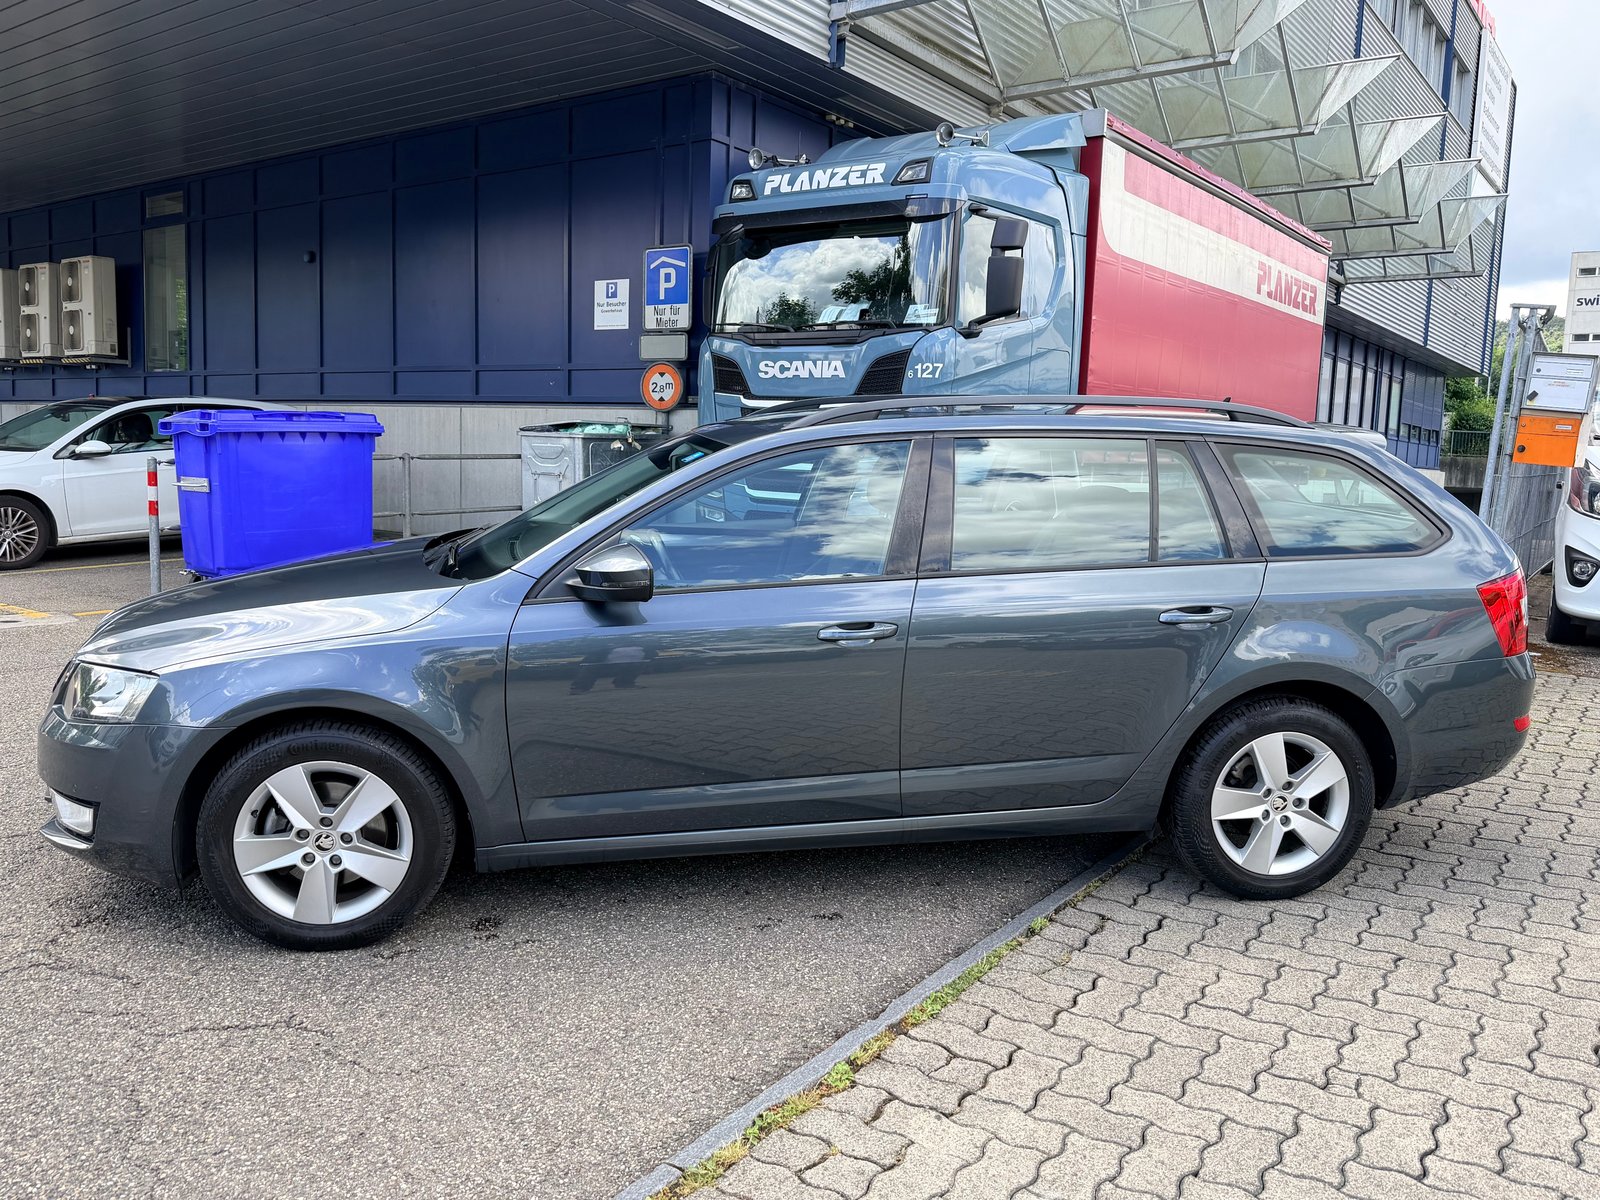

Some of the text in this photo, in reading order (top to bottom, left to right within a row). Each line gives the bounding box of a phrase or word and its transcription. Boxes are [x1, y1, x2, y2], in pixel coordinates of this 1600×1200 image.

[764, 163, 886, 195] PLANZER
[608, 284, 615, 297] P
[659, 267, 676, 300] P
[1256, 260, 1317, 316] PLANZER
[653, 304, 681, 316] Nur für
[656, 317, 679, 328] Mieter
[758, 360, 846, 379] SCANIA
